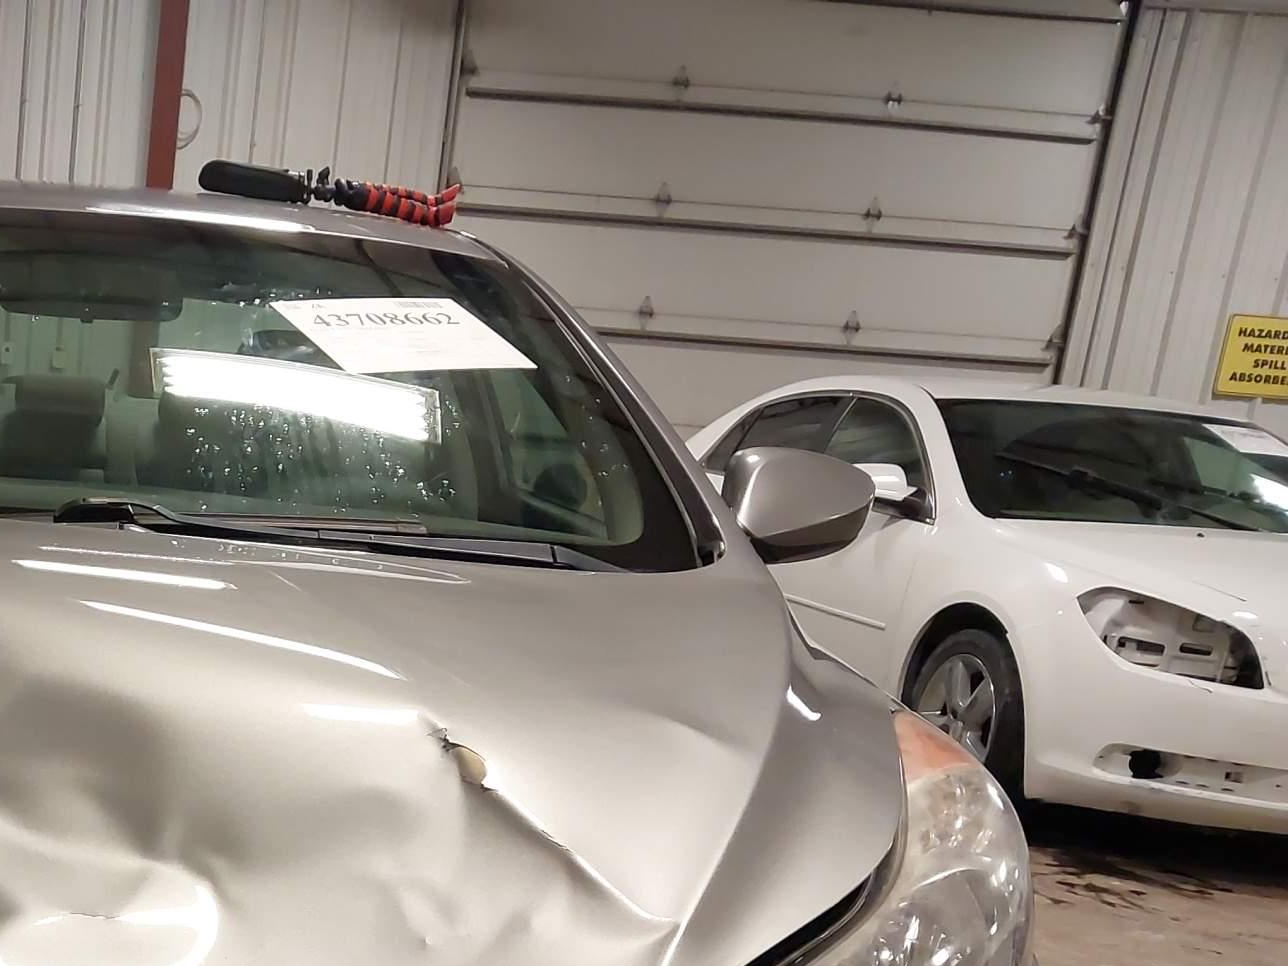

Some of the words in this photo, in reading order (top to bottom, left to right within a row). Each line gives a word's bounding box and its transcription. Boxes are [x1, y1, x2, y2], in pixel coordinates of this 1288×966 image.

[313, 313, 460, 327] 43708662
[1238, 327, 1288, 340] HAZARD
[1253, 358, 1286, 370] SPILL
[1229, 371, 1288, 385] ABSORBE
